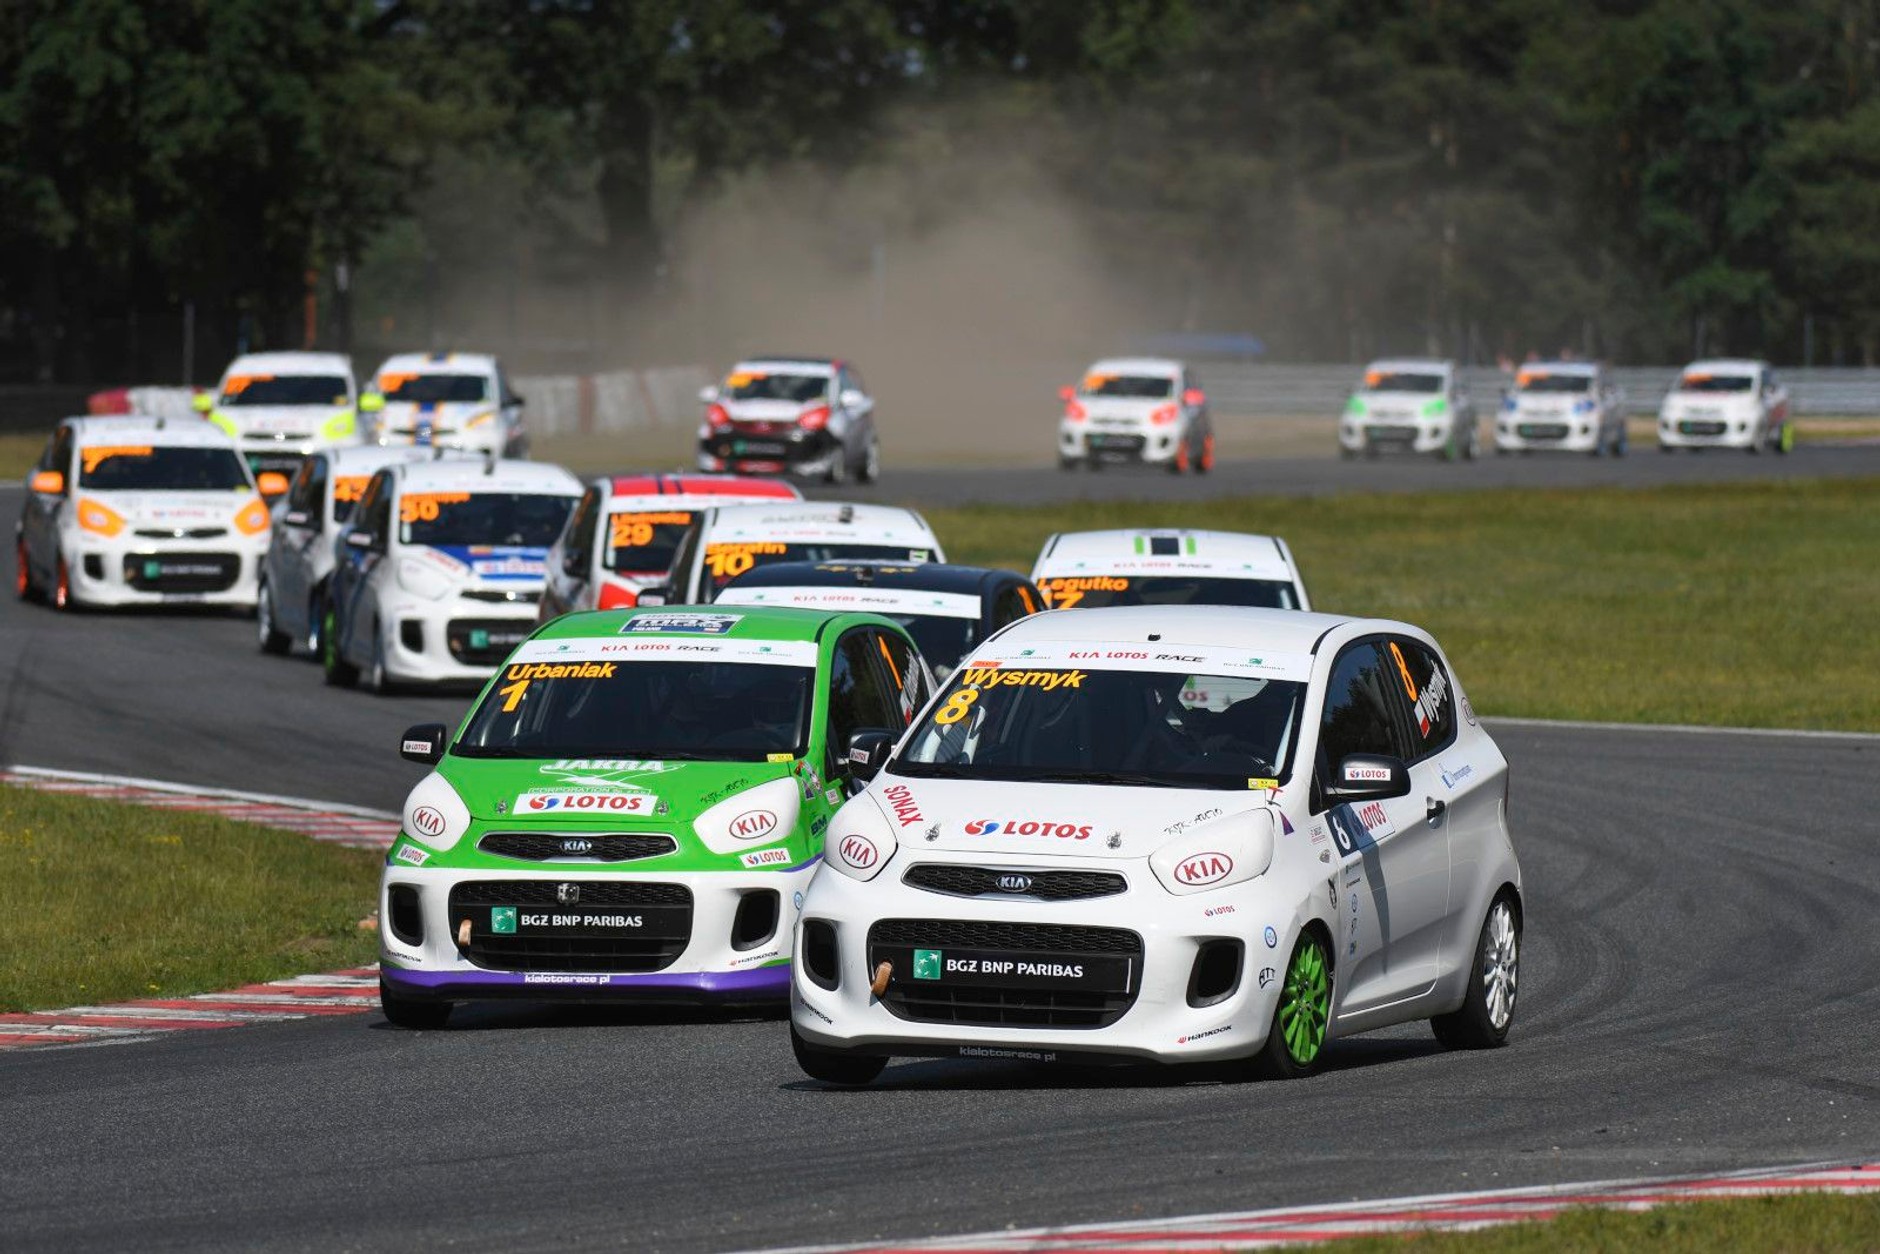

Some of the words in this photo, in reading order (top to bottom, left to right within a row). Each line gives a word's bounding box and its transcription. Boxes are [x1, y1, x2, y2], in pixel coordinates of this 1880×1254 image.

[612, 524, 654, 547] 29
[705, 552, 754, 576] 10
[1037, 575, 1129, 594] Legutko
[1069, 651, 1100, 659] KIA
[1106, 652, 1149, 660] LOTOS
[1154, 653, 1206, 663] RACE
[507, 661, 619, 681] Urbaniak
[962, 669, 1087, 691] Wysmyk
[499, 680, 530, 712] 1
[934, 688, 979, 725] 8
[1362, 770, 1387, 778] LOTOS
[563, 795, 643, 810] LOTOS
[883, 784, 924, 827] SONAX
[415, 809, 440, 834] KIA
[736, 814, 772, 836] KIA
[1360, 802, 1387, 832] LOTOS
[1002, 820, 1093, 840] LOTOS
[563, 840, 586, 850] KIA
[843, 838, 870, 866] KIA
[759, 850, 786, 864] LOTOS
[1182, 857, 1226, 881] KIA
[999, 876, 1025, 888] KIA
[1213, 905, 1236, 915] LOTOS
[552, 915, 581, 927] BNP
[583, 915, 643, 927] PARIBAS
[981, 960, 1014, 974] BNP
[1017, 962, 1084, 978] PARIBAS
